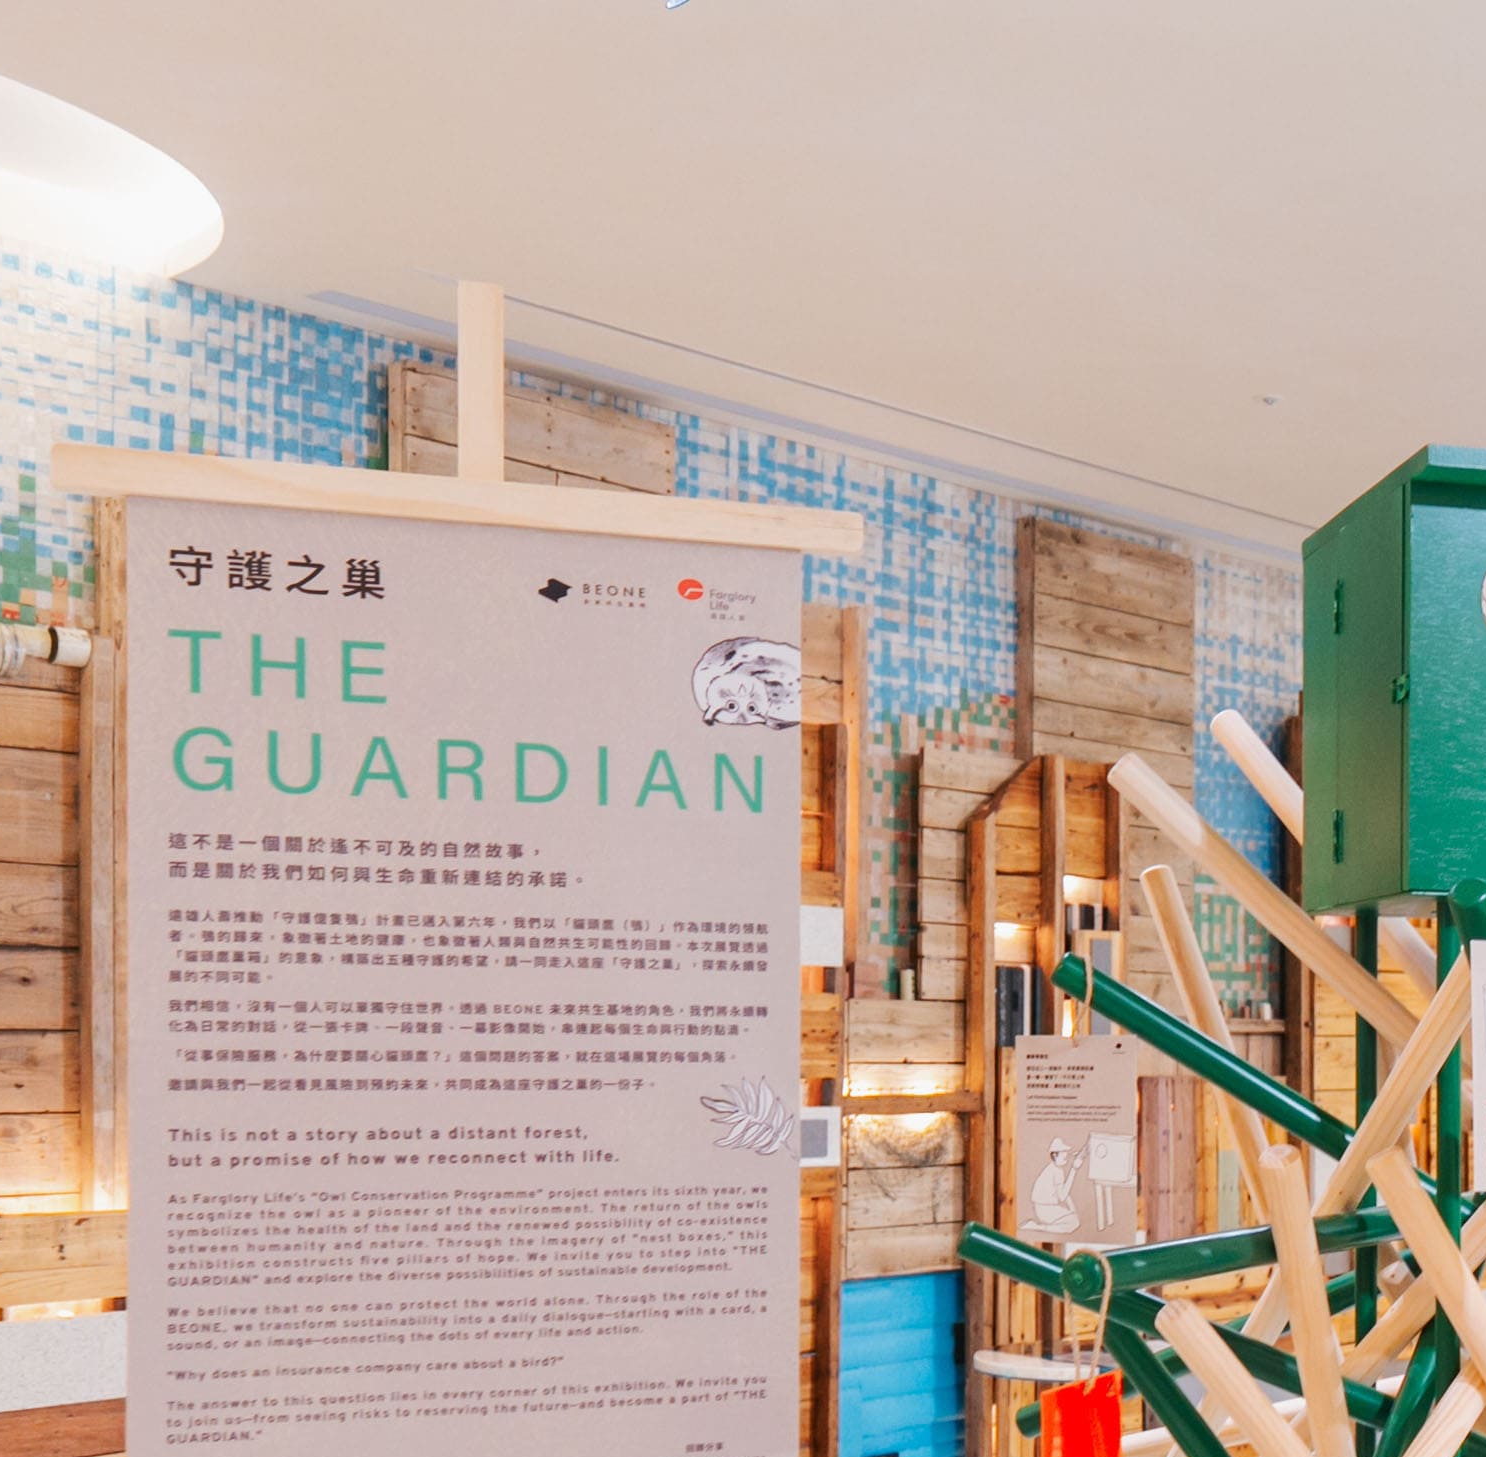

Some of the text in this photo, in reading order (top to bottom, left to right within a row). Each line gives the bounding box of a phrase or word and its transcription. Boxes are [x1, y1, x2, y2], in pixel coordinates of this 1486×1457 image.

[168, 546, 386, 600] 守護之巢
[582, 583, 646, 598] BEONE
[709, 588, 756, 604] Farglory
[709, 601, 730, 611] Life
[167, 629, 387, 704] THE
[171, 726, 764, 814] GUARDIAN
[168, 832, 542, 860] 這不是一個關於遙不可及的自然故事，
[168, 861, 584, 889] 而是關於我們如何與生命重新連結的承諾。
[493, 1004, 543, 1016] BEONE
[168, 1125, 587, 1144] This is not a story about a distant forest,
[168, 1149, 618, 1169] but a promise of how we reconnect with life.
[167, 1193, 187, 1204] As
[192, 1192, 258, 1206] Farglory
[263, 1191, 305, 1203] Life's
[350, 1189, 448, 1201] Conservation
[547, 1187, 598, 1200] project
[603, 1187, 647, 1197] enters
[652, 1186, 669, 1196] its
[674, 1185, 707, 1195] sixth
[712, 1186, 746, 1197] year,
[750, 1186, 767, 1194] we
[167, 1214, 767, 1240] symbolizes the health of the land and the renewed possibility of co-existence
[167, 1242, 239, 1254] between
[246, 1240, 326, 1254] humanity
[333, 1239, 362, 1250] and
[369, 1238, 428, 1249] nature.
[436, 1236, 502, 1250] Through
[509, 1236, 534, 1246] the
[541, 1234, 604, 1248] imagery
[610, 1233, 625, 1244] of
[739, 1229, 767, 1240] this
[166, 1287, 767, 1317] We believe that no one can protect the world alone. Through the role of the
[211, 1368, 247, 1379] does
[251, 1368, 270, 1377] an
[275, 1363, 350, 1376] insurance
[355, 1362, 421, 1375] company
[425, 1361, 457, 1371] care
[462, 1358, 503, 1370] about
[508, 1359, 516, 1368] a
